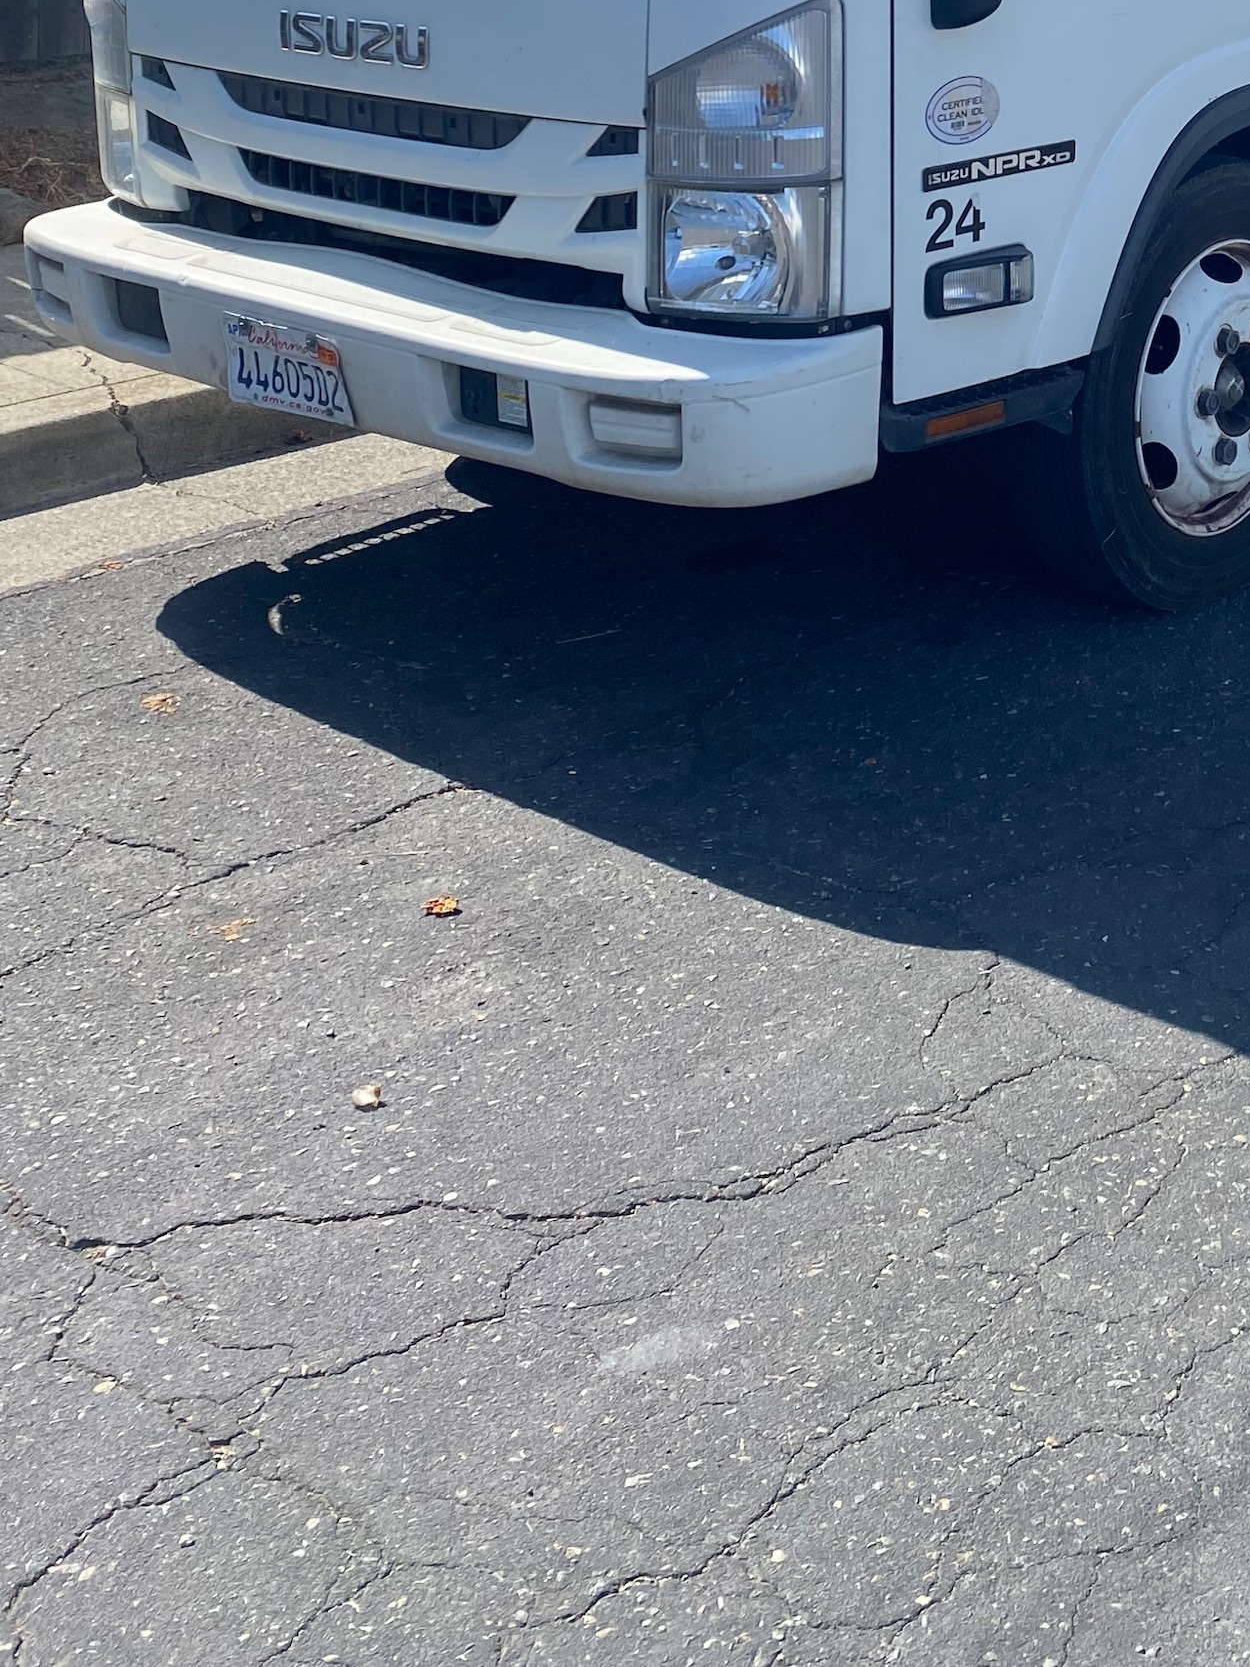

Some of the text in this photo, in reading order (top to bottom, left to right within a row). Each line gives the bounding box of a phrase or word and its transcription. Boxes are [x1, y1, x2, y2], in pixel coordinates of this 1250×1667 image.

[280, 9, 430, 70] ISUZU
[941, 95, 983, 111] CERTIFIE
[937, 107, 985, 122] CLEAN IDL
[928, 167, 969, 185] ISUZU
[925, 198, 986, 253] 24
[237, 347, 345, 413] 44605D2
[261, 395, 328, 414] dmv.ca.gov
